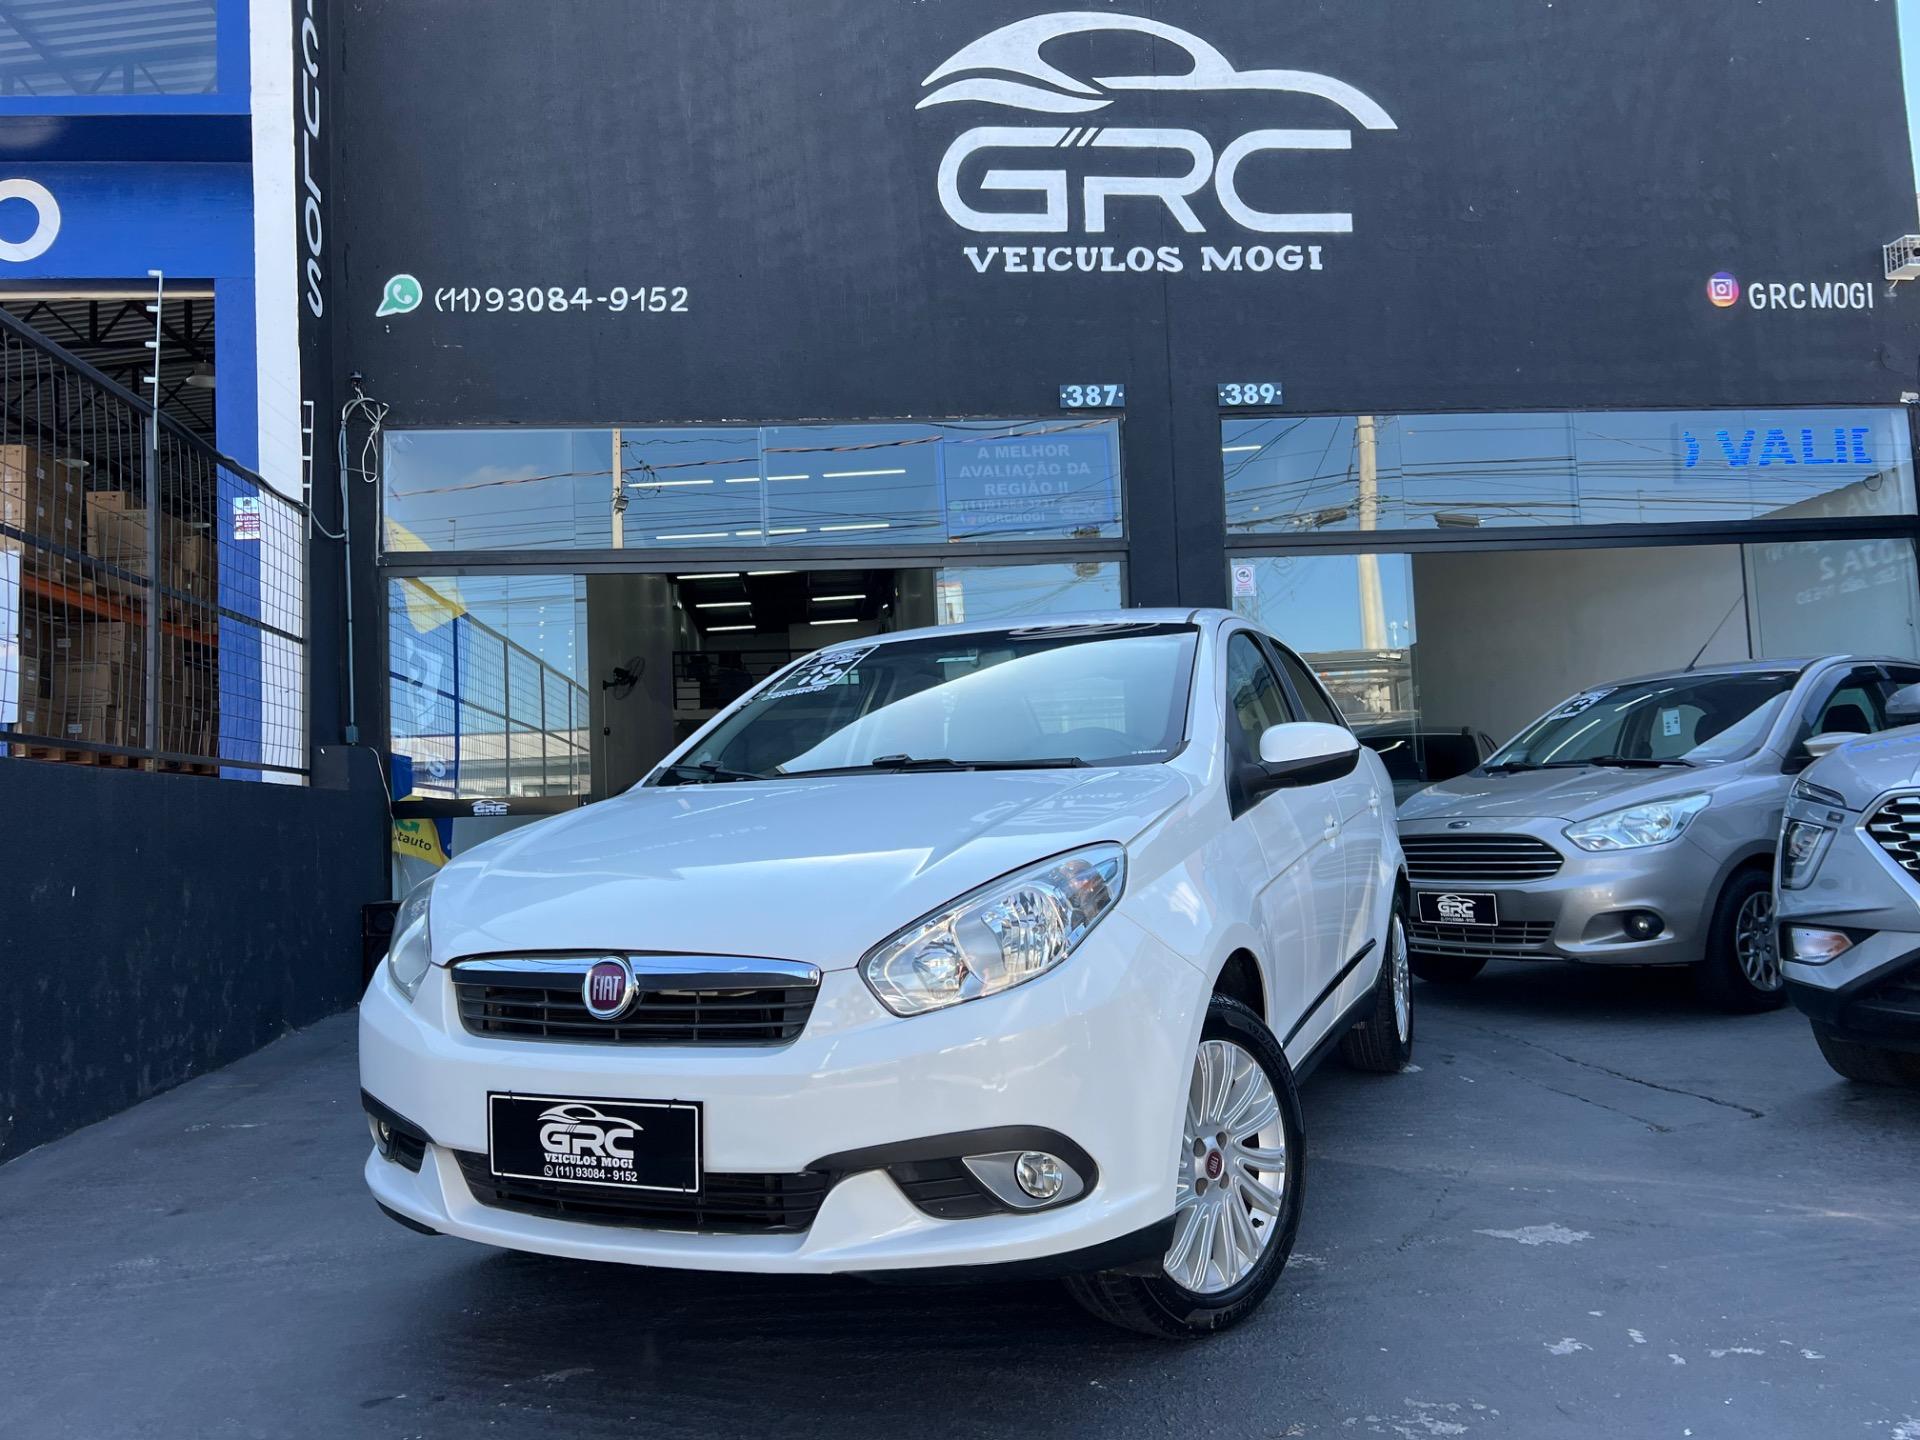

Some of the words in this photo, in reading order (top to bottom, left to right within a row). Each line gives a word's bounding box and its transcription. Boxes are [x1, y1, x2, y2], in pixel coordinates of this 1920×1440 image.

[937, 126, 1353, 233] GRC
[963, 246, 1184, 273] VEICULOS
[1201, 245, 1324, 272] MOGI
[434, 286, 689, 313] (11)93084-9152
[1748, 282, 1874, 310] GRCMOGI
[1066, 384, 1118, 407] 387
[1225, 383, 1275, 406] 389
[977, 446, 990, 460] A
[995, 443, 1070, 460] MELHOR
[959, 460, 1061, 478] AVALIAÇÃO
[1066, 461, 1091, 475] DA
[984, 480, 1052, 497] REGIÃO
[393, 830, 432, 852] tauto
[1437, 901, 1474, 914] GRC
[592, 975, 622, 1001] FIAT
[539, 1122, 635, 1160] GRC
[544, 1152, 598, 1167] VEICULOS
[601, 1156, 634, 1169] MOGI
[555, 1164, 575, 1179] (11)
[575, 1166, 606, 1181] 93084
[612, 1169, 638, 1183] 9152
